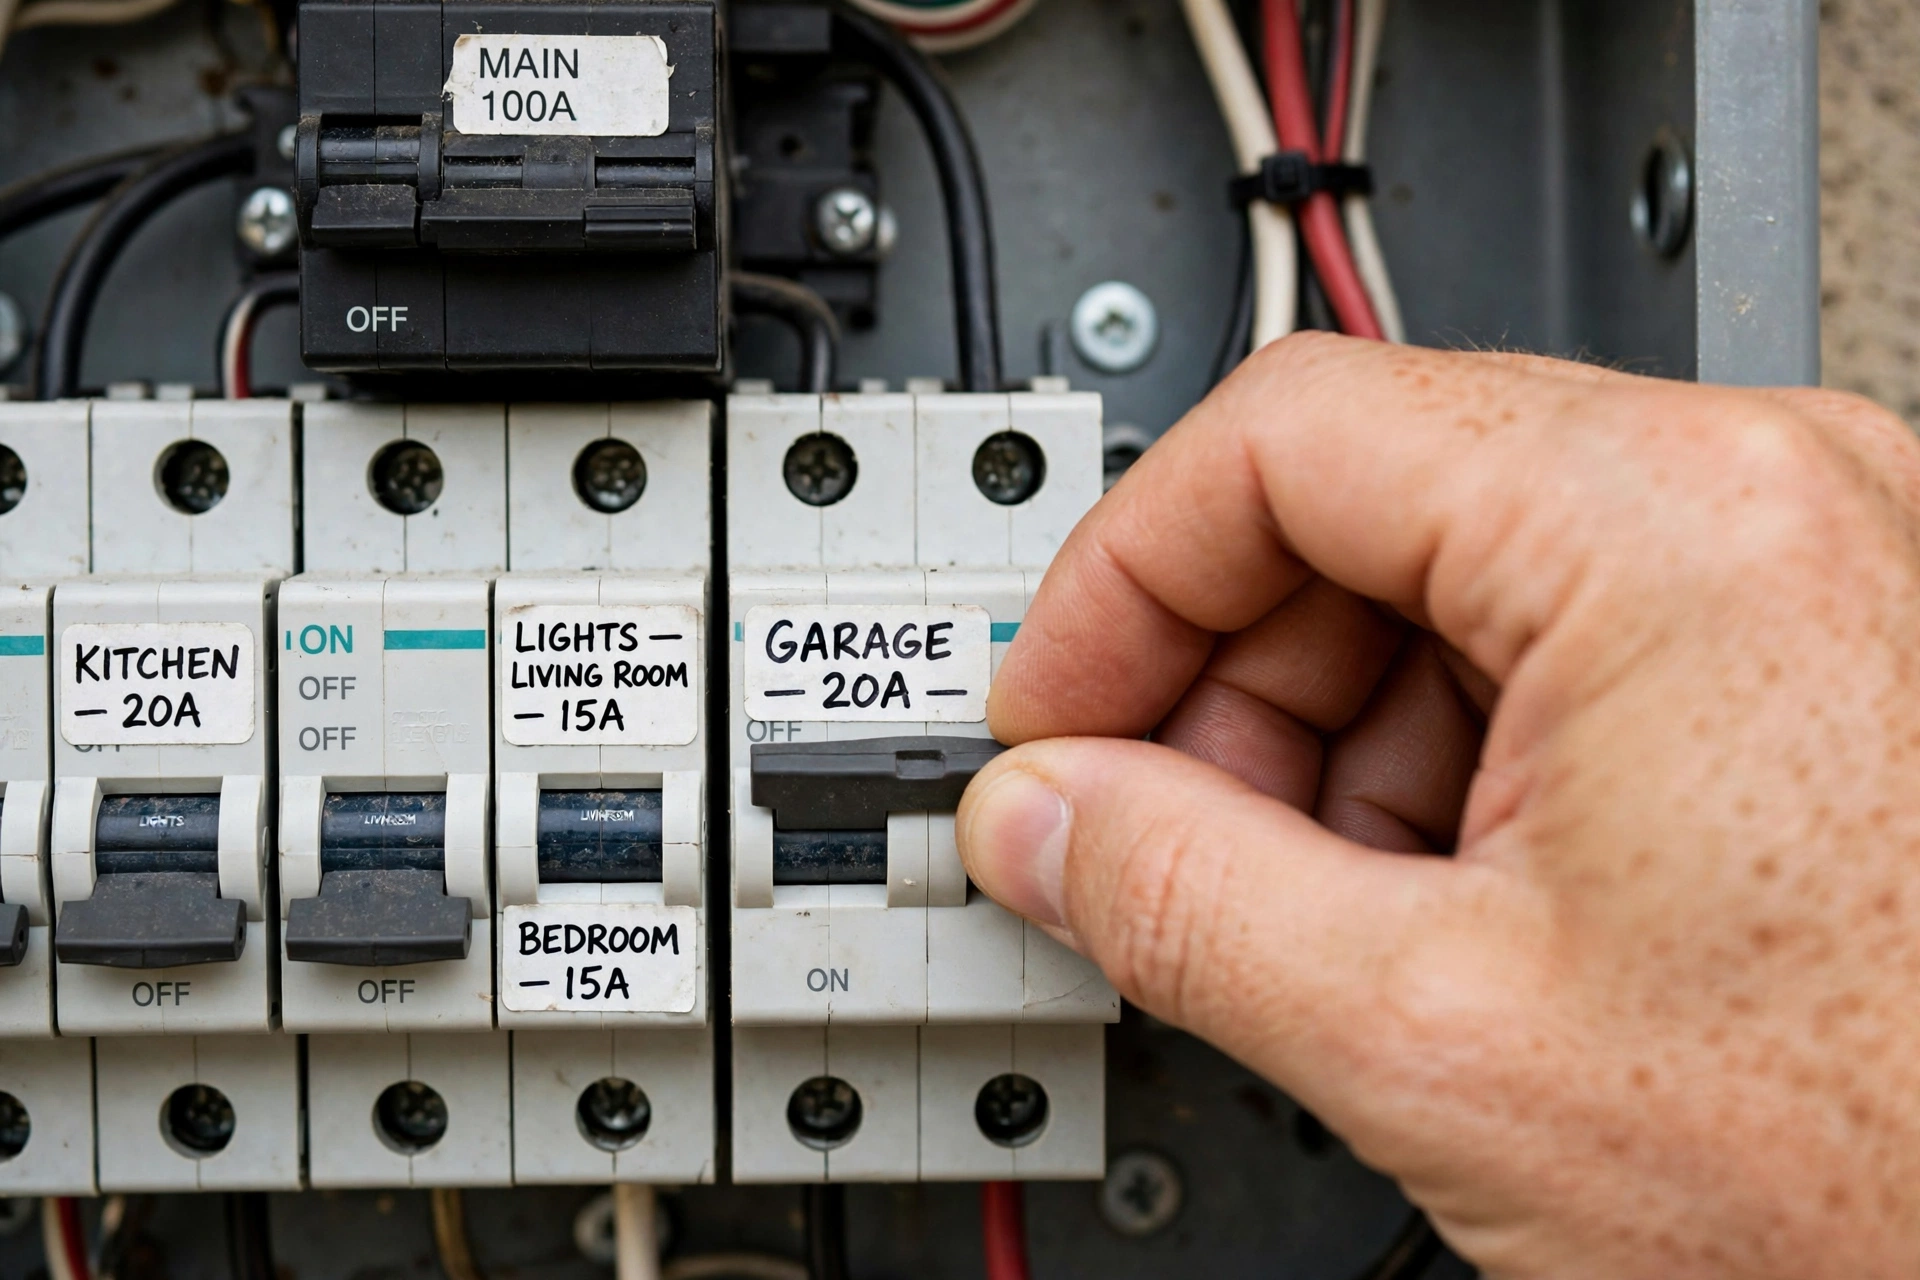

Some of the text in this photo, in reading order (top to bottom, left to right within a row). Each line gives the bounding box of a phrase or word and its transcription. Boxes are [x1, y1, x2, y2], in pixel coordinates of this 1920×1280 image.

[479, 48, 579, 79] MAIN
[482, 90, 577, 122] 100A
[346, 306, 408, 333] OFF
[299, 624, 353, 654] ON
[515, 621, 638, 653] LIGHTS
[765, 619, 954, 663] GARAGE
[76, 643, 239, 682] KITCHEN
[511, 660, 689, 689] LIVING ROOM
[298, 676, 357, 701] OFF
[822, 670, 911, 709] 20A
[122, 692, 201, 728] 20A
[561, 698, 625, 732] 15A
[298, 726, 357, 752] OFF
[746, 720, 802, 742] OFF
[518, 920, 680, 955] BEDROOM
[132, 981, 191, 1007] OFF
[357, 979, 416, 1004] OFF
[566, 964, 630, 1000] 15A
[806, 967, 849, 993] ON
